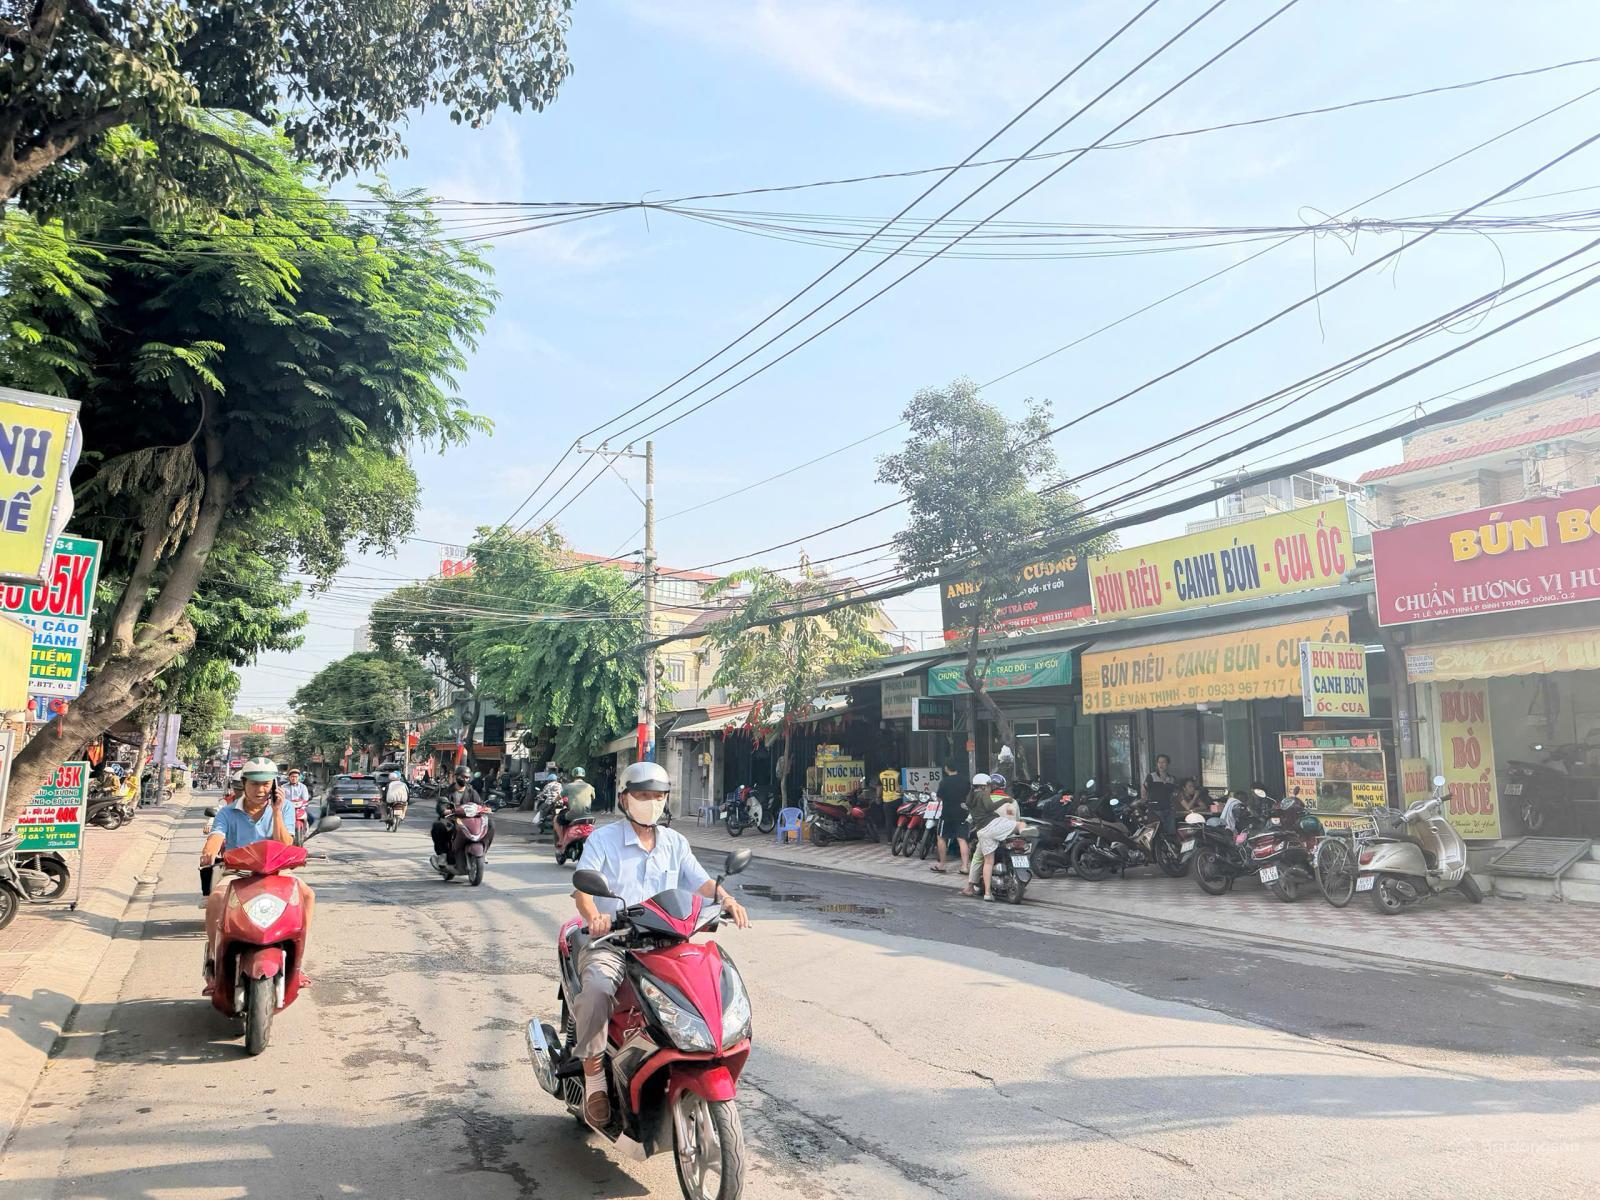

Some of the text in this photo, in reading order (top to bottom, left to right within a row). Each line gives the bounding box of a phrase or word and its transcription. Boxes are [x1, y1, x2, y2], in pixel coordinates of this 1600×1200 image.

[55, 540, 73, 551] 54
[1449, 512, 1548, 562] BÚN
[1095, 511, 1346, 613] BÚN RIÊU CANH BÚN CUA ỐC
[946, 581, 975, 599] ANH
[1394, 582, 1455, 612] CHUẨN
[1462, 578, 1531, 602] HƯƠNG
[1538, 573, 1562, 595] VỊ
[1101, 657, 1129, 688] BÚN
[1132, 652, 1164, 682] RIÊU
[1175, 648, 1218, 678] CANH
[1223, 637, 1260, 673] BÚN
[1312, 646, 1363, 671] BÚN RIÊU
[1083, 690, 1111, 710] 31B
[1207, 683, 1235, 697] 0933
[1239, 681, 1259, 694] 967
[1263, 679, 1285, 692] 717
[1314, 676, 1342, 694] CANH
[1344, 673, 1365, 695] BÚN
[1317, 697, 1365, 713] ỐC CUA
[1440, 681, 1484, 723] BÚN
[1452, 727, 1481, 769] BÒ
[56, 766, 81, 788] 35K
[1447, 767, 1494, 815] HUẾ
[56, 807, 79, 823] 40K
